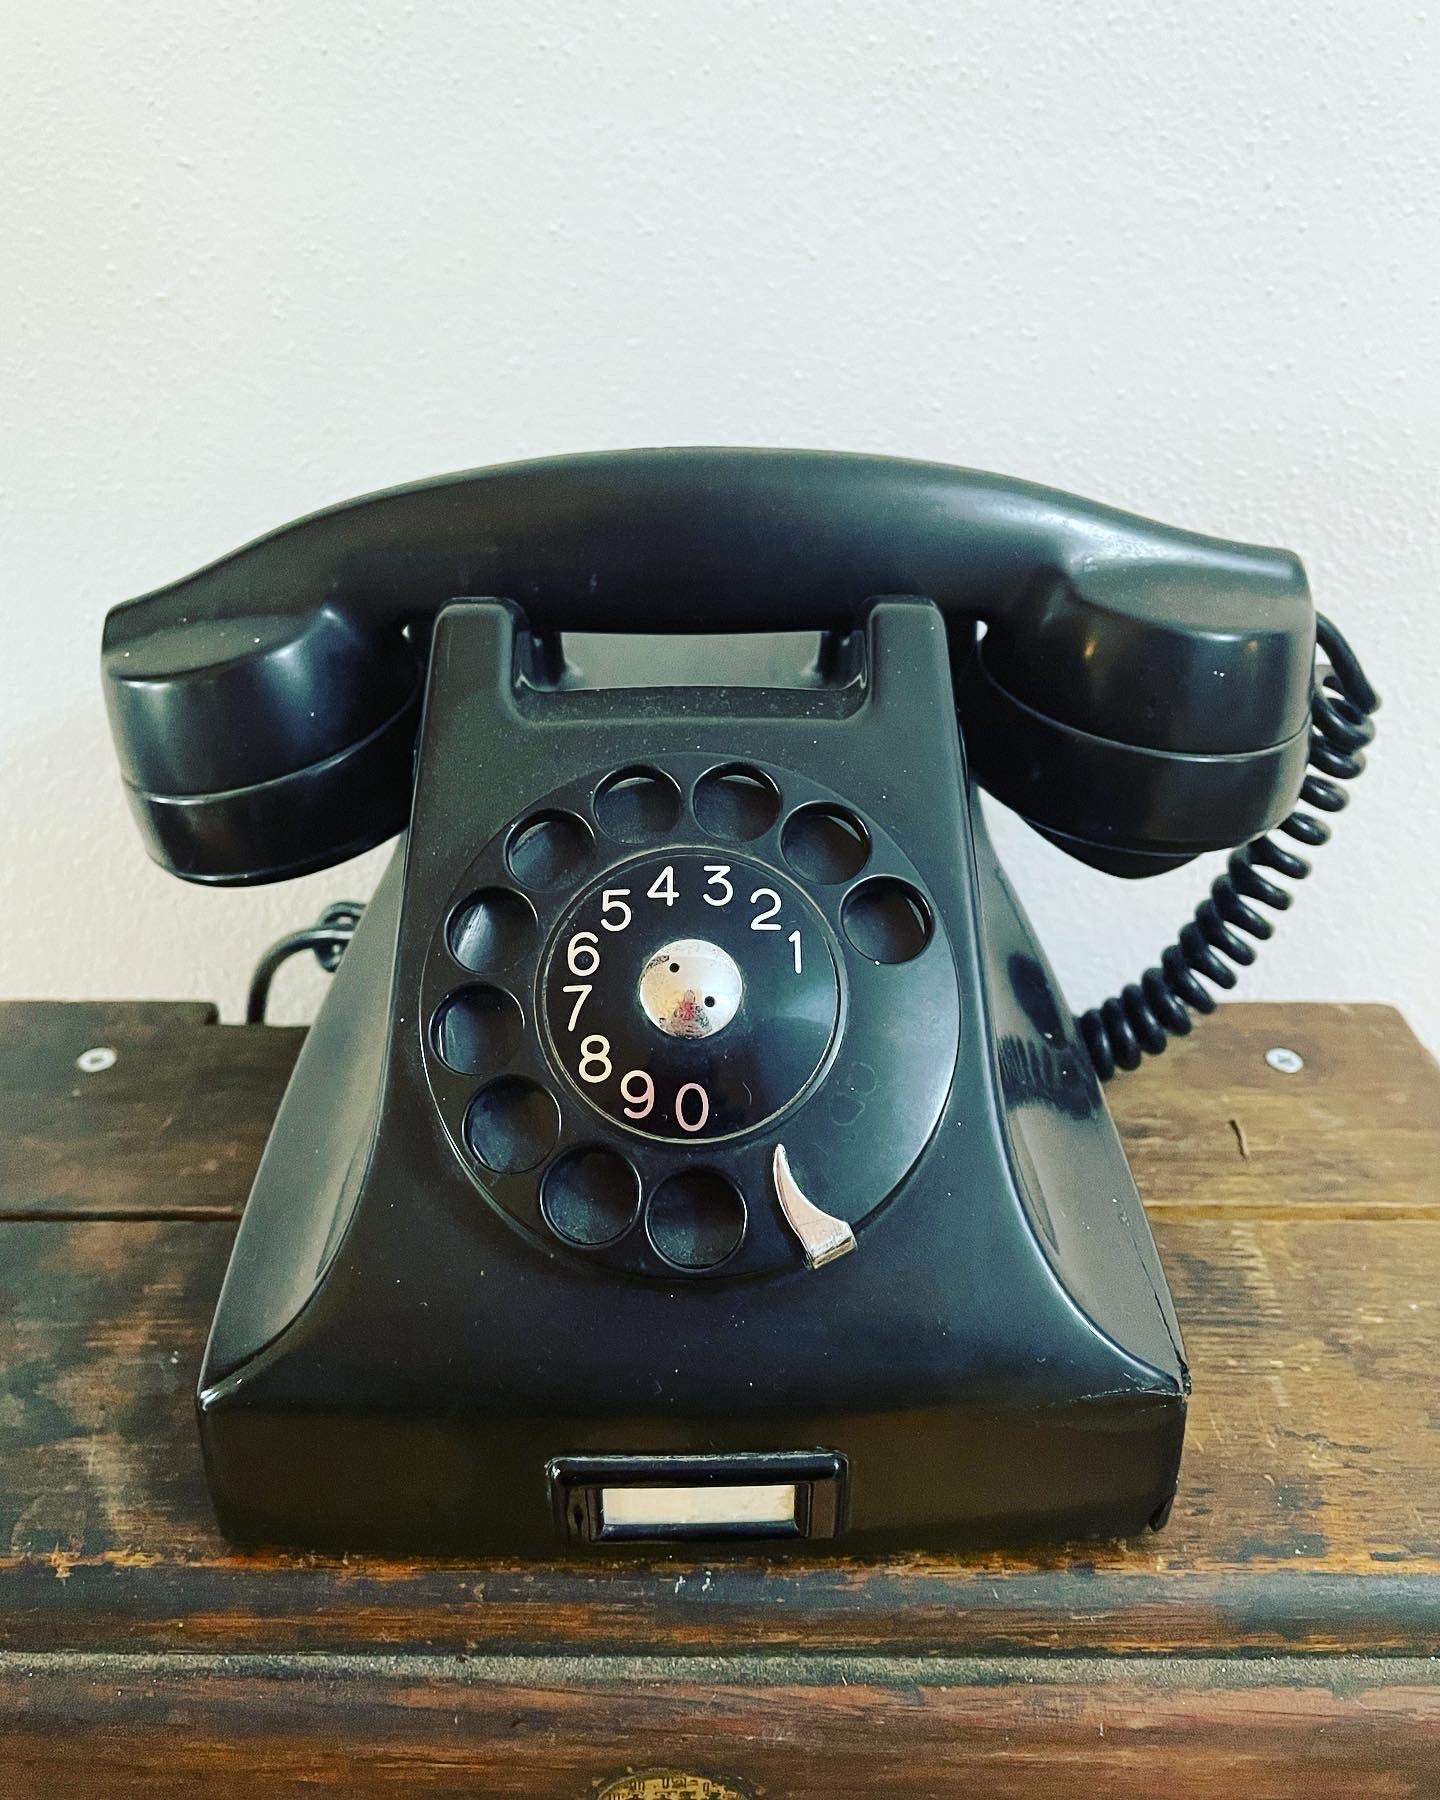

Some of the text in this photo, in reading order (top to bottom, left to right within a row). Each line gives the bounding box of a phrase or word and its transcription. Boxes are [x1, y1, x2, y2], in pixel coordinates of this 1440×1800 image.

[562, 865, 802, 1132] 1 2 3 4 5 6 7 8 9 0
